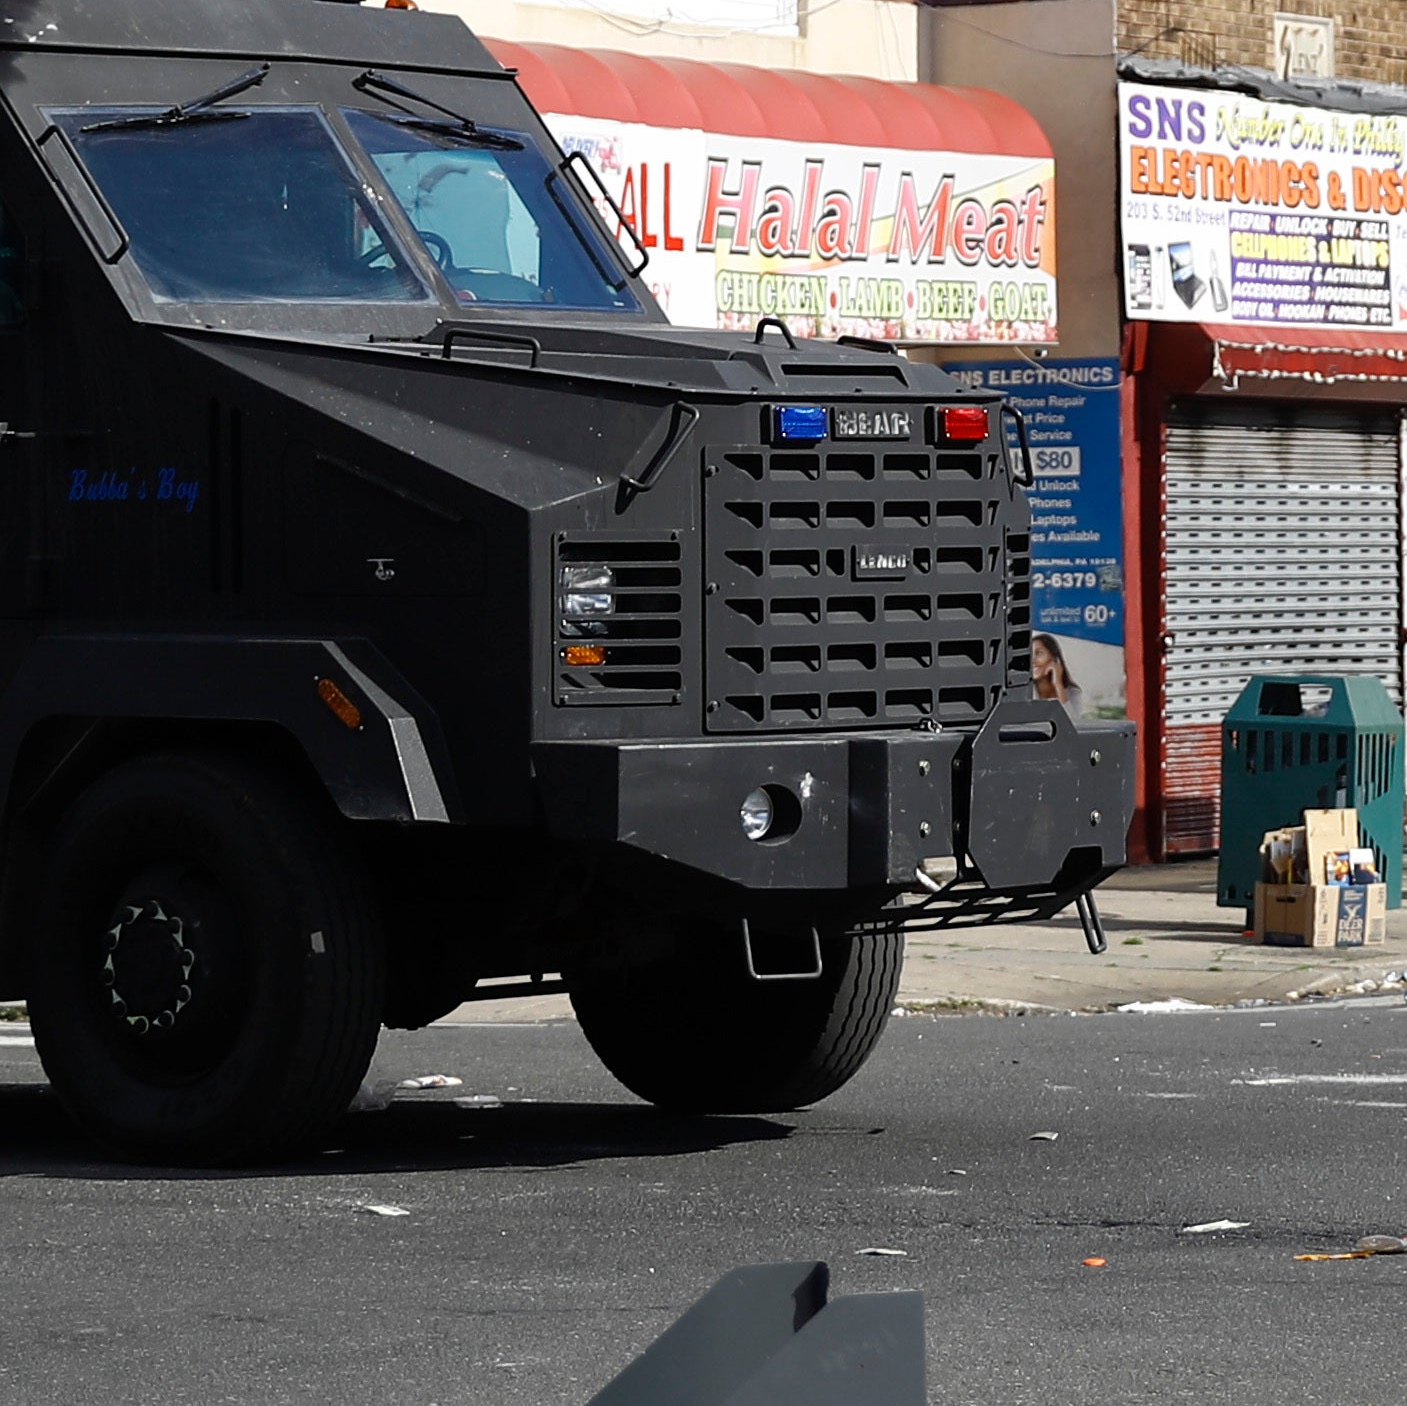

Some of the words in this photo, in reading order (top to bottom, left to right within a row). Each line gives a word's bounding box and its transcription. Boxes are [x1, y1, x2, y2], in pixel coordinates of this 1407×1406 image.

[1128, 94, 1205, 144] SNS
[1216, 103, 1285, 150] Number
[1291, 112, 1323, 151] One
[1353, 117, 1405, 170] Philly
[1131, 145, 1320, 209] ELECTRONICS
[1327, 171, 1346, 210] &
[696, 157, 881, 262] Halal
[886, 171, 1046, 268] Meat
[1230, 212, 1271, 232] REPAIR
[1275, 216, 1328, 236] UNLOCK
[1332, 220, 1357, 237] BUY
[1360, 221, 1388, 239] SELL
[1231, 231, 1317, 262] CELLPHONES
[1331, 238, 1389, 267] LAPTOPS
[1258, 264, 1312, 281] PAYMENT
[716, 270, 827, 315] CHICKEN
[839, 276, 904, 318] LAMB
[917, 279, 978, 320] BEEF
[1232, 281, 1310, 300] ACCESSORIES
[988, 367, 1113, 385] ELECTRONICS
[1010, 395, 1045, 406] Phone
[1048, 395, 1086, 408] Repair
[1035, 412, 1065, 423] Price
[1030, 430, 1072, 440] Service
[1036, 450, 1072, 470] $80
[1039, 479, 1080, 492] Unlock
[1031, 514, 1077, 526] Laptops
[1047, 530, 1100, 542] Available
[860, 554, 907, 569] LENCO
[1032, 572, 1097, 589] 2-6379
[1339, 919, 1363, 930] DEER
[1338, 930, 1362, 943] PARK
